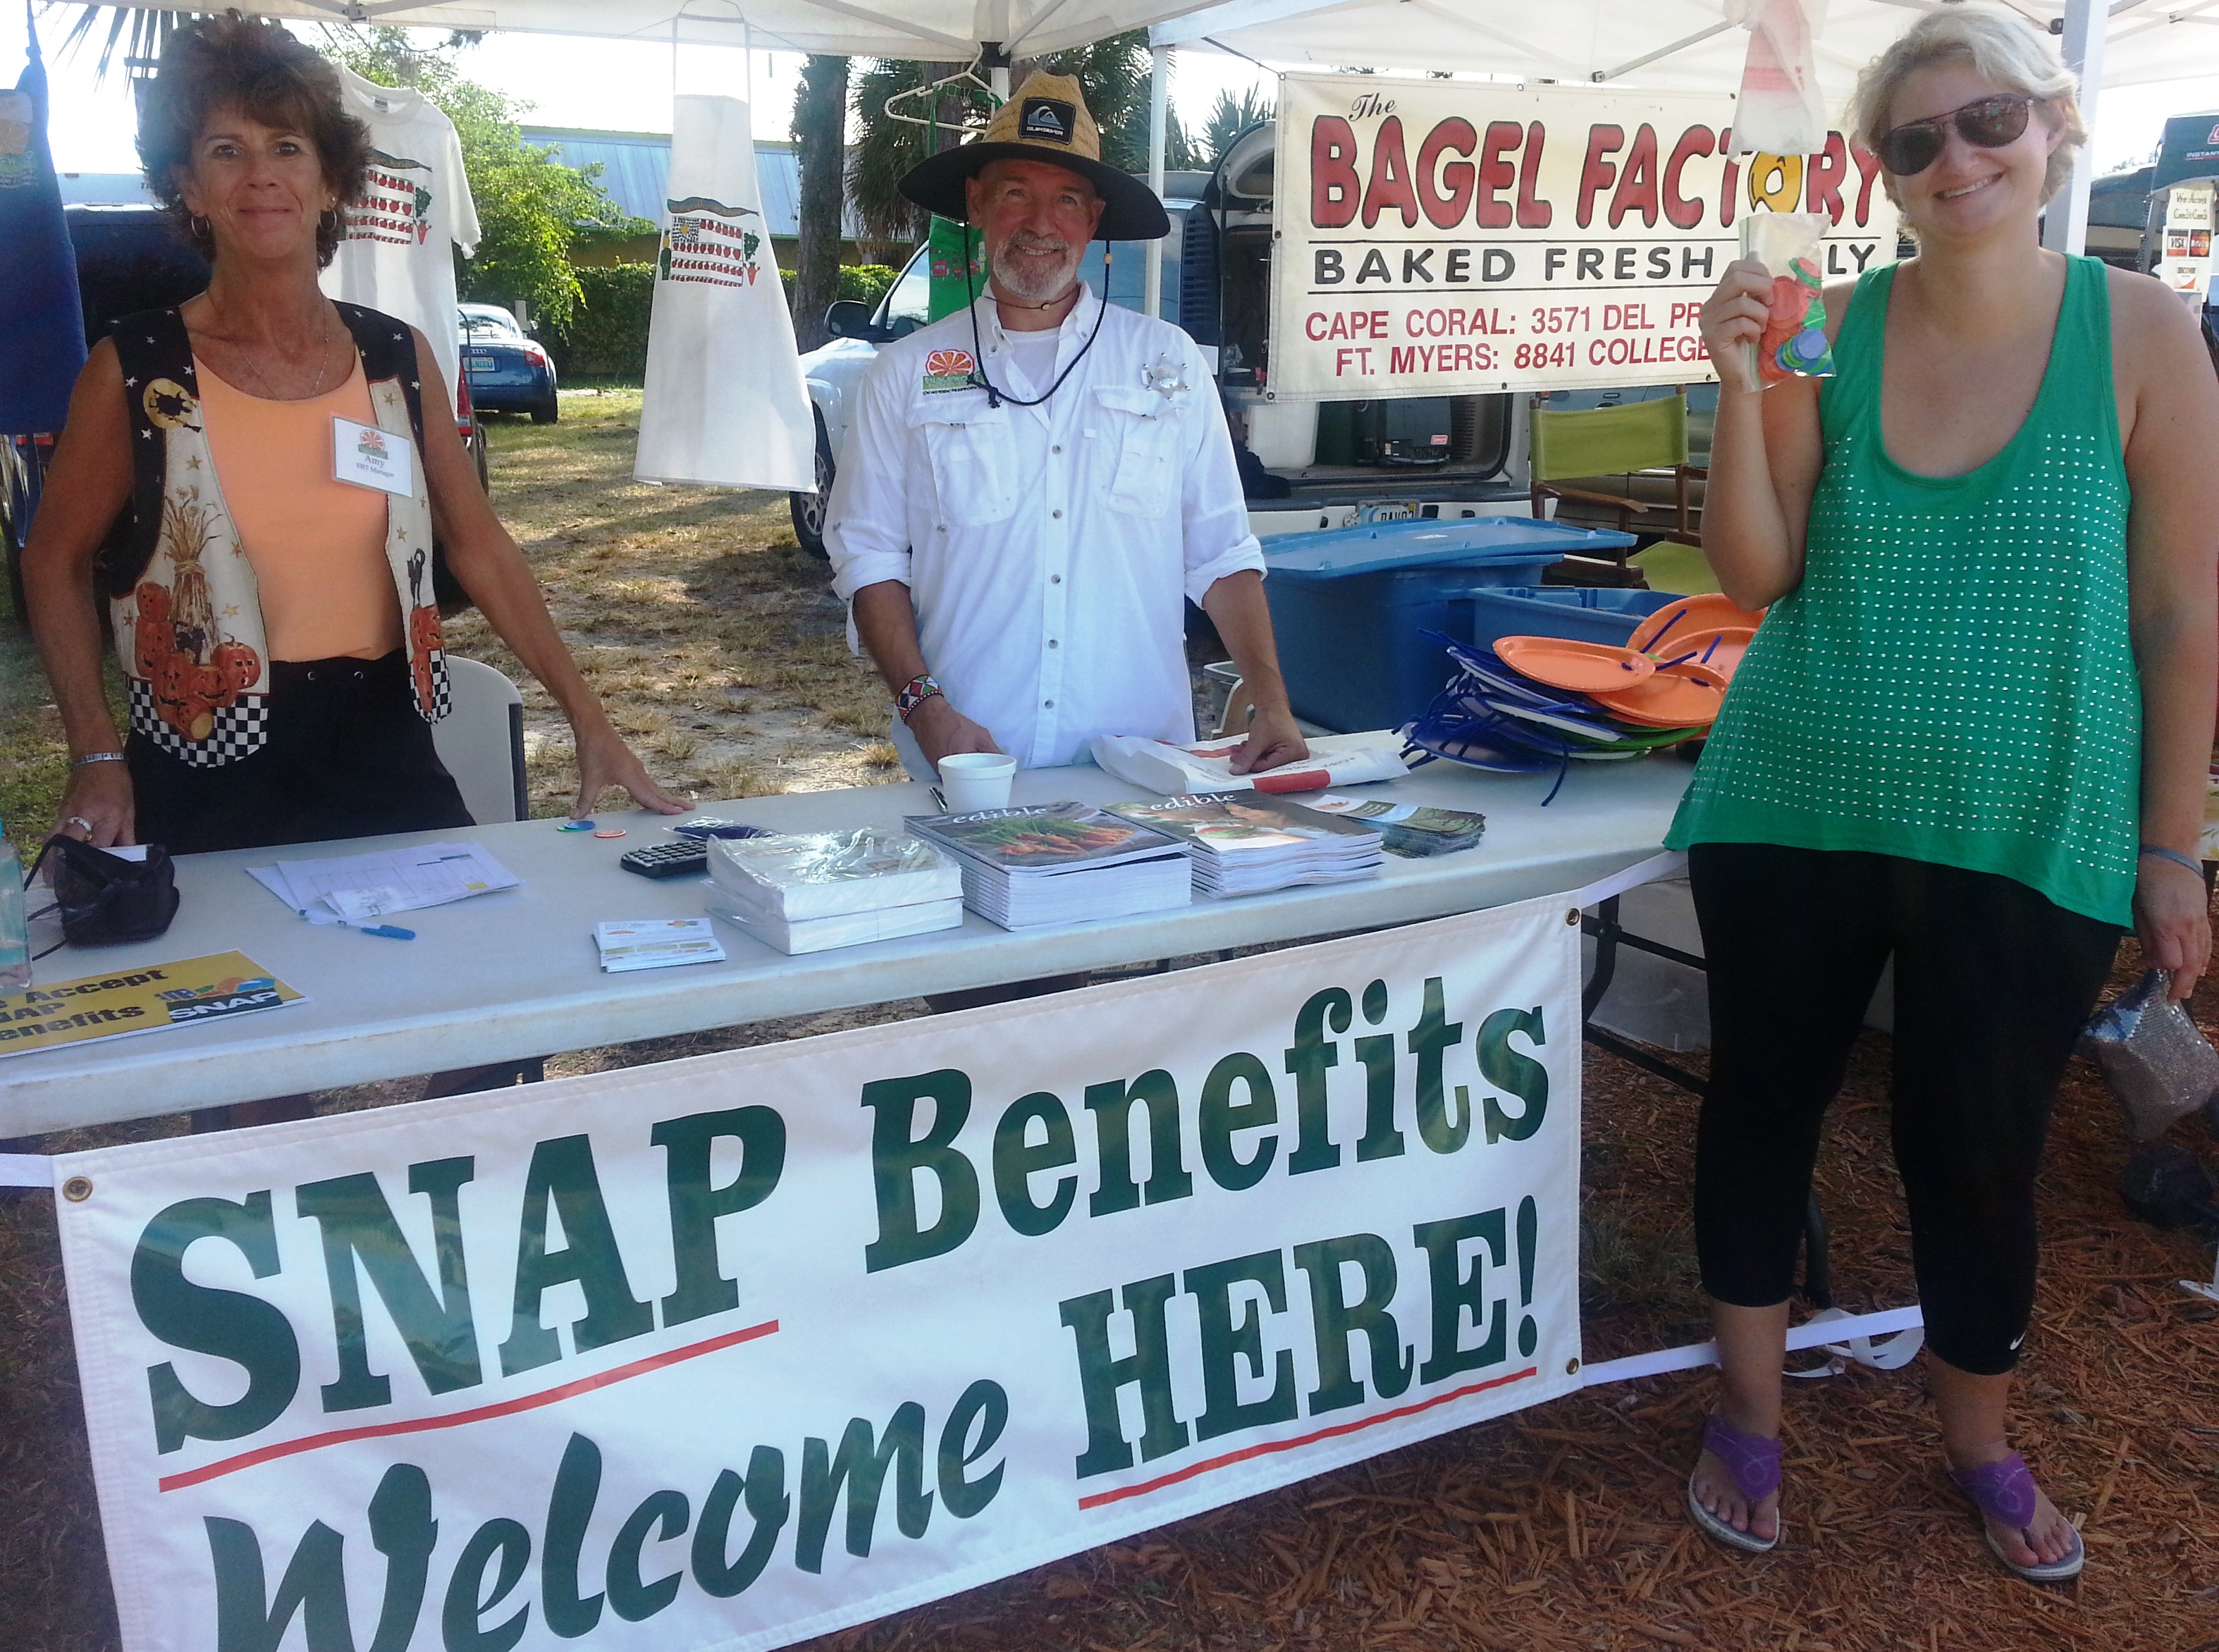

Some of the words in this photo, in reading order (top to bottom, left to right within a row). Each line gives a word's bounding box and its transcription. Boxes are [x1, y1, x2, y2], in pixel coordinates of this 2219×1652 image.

[1348, 92, 1396, 121] The
[1310, 115, 1552, 230] BAGEL
[1315, 248, 1516, 284] BAKED
[1545, 247, 1714, 281] FRESH
[1305, 311, 1389, 341] CAPE
[1407, 308, 1516, 338] CORAL:
[1532, 307, 1590, 334] 3571
[1604, 304, 1655, 331] DEL
[1336, 347, 1375, 376] FT.
[1390, 344, 1498, 374] MYERS:
[1515, 343, 1575, 369] 8841
[1588, 336, 1710, 366] COLLEGE
[365, 455, 385, 468] Amy
[952, 806, 1048, 824] edible
[1150, 792, 1237, 811] edible
[26, 969, 168, 1004] Accept
[0, 1006, 145, 1041] enefits
[170, 992, 279, 1020] SNAP
[130, 1104, 787, 1456] SNAP
[860, 976, 1549, 1274] Benefits
[204, 1379, 1009, 1652] Welcome
[1058, 1194, 1538, 1480] HERE!
